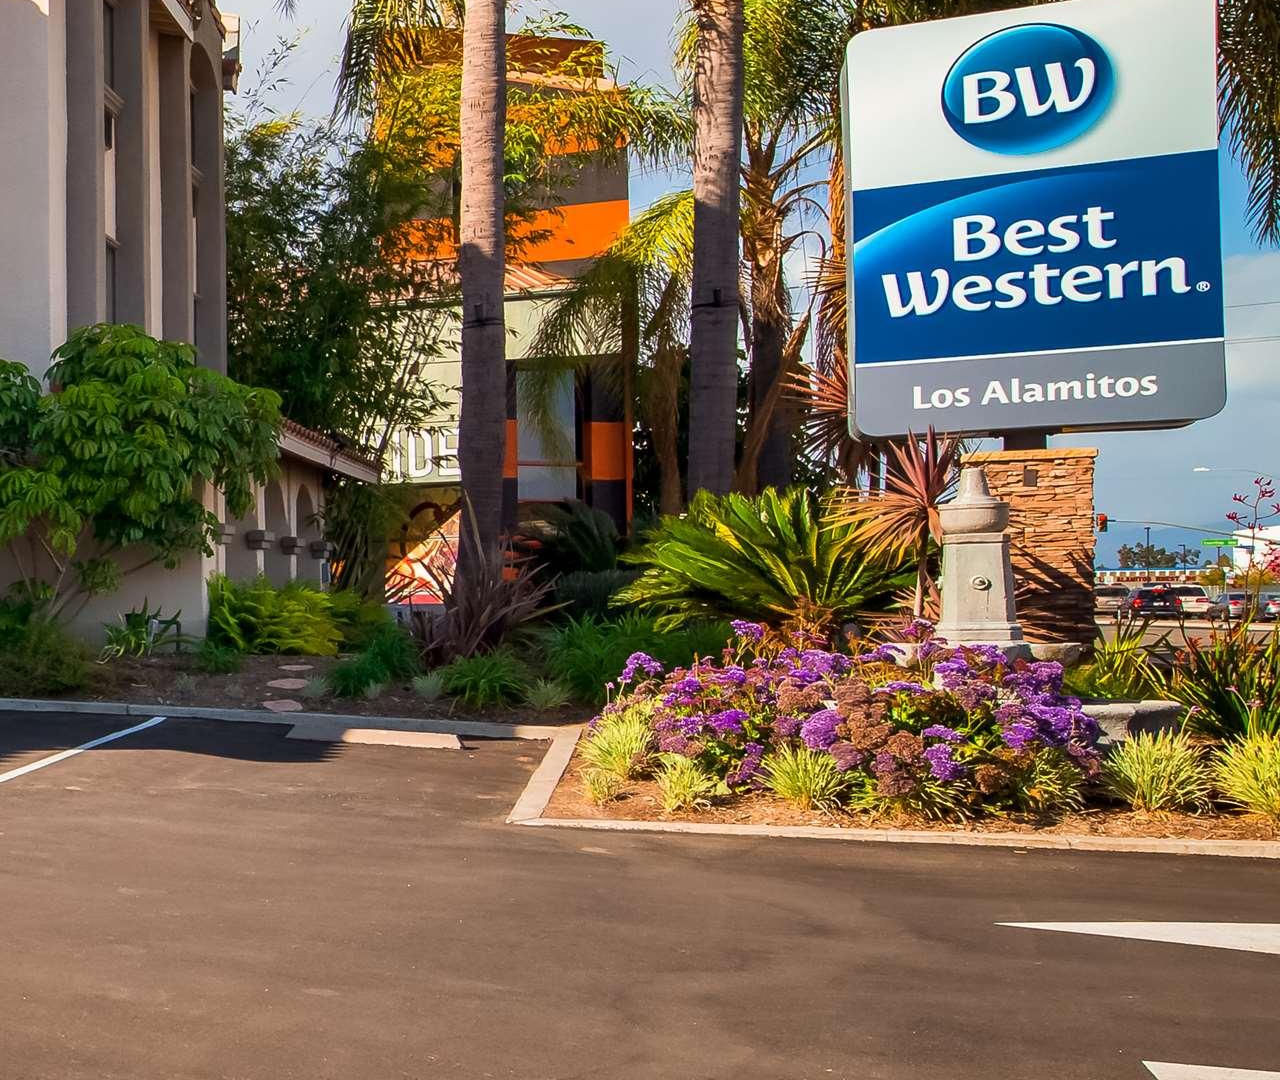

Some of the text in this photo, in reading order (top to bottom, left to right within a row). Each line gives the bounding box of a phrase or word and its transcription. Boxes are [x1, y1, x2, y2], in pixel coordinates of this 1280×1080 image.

[962, 57, 1095, 124] BW
[952, 206, 1118, 262] Best
[912, 372, 1158, 410] Los Alamitos
